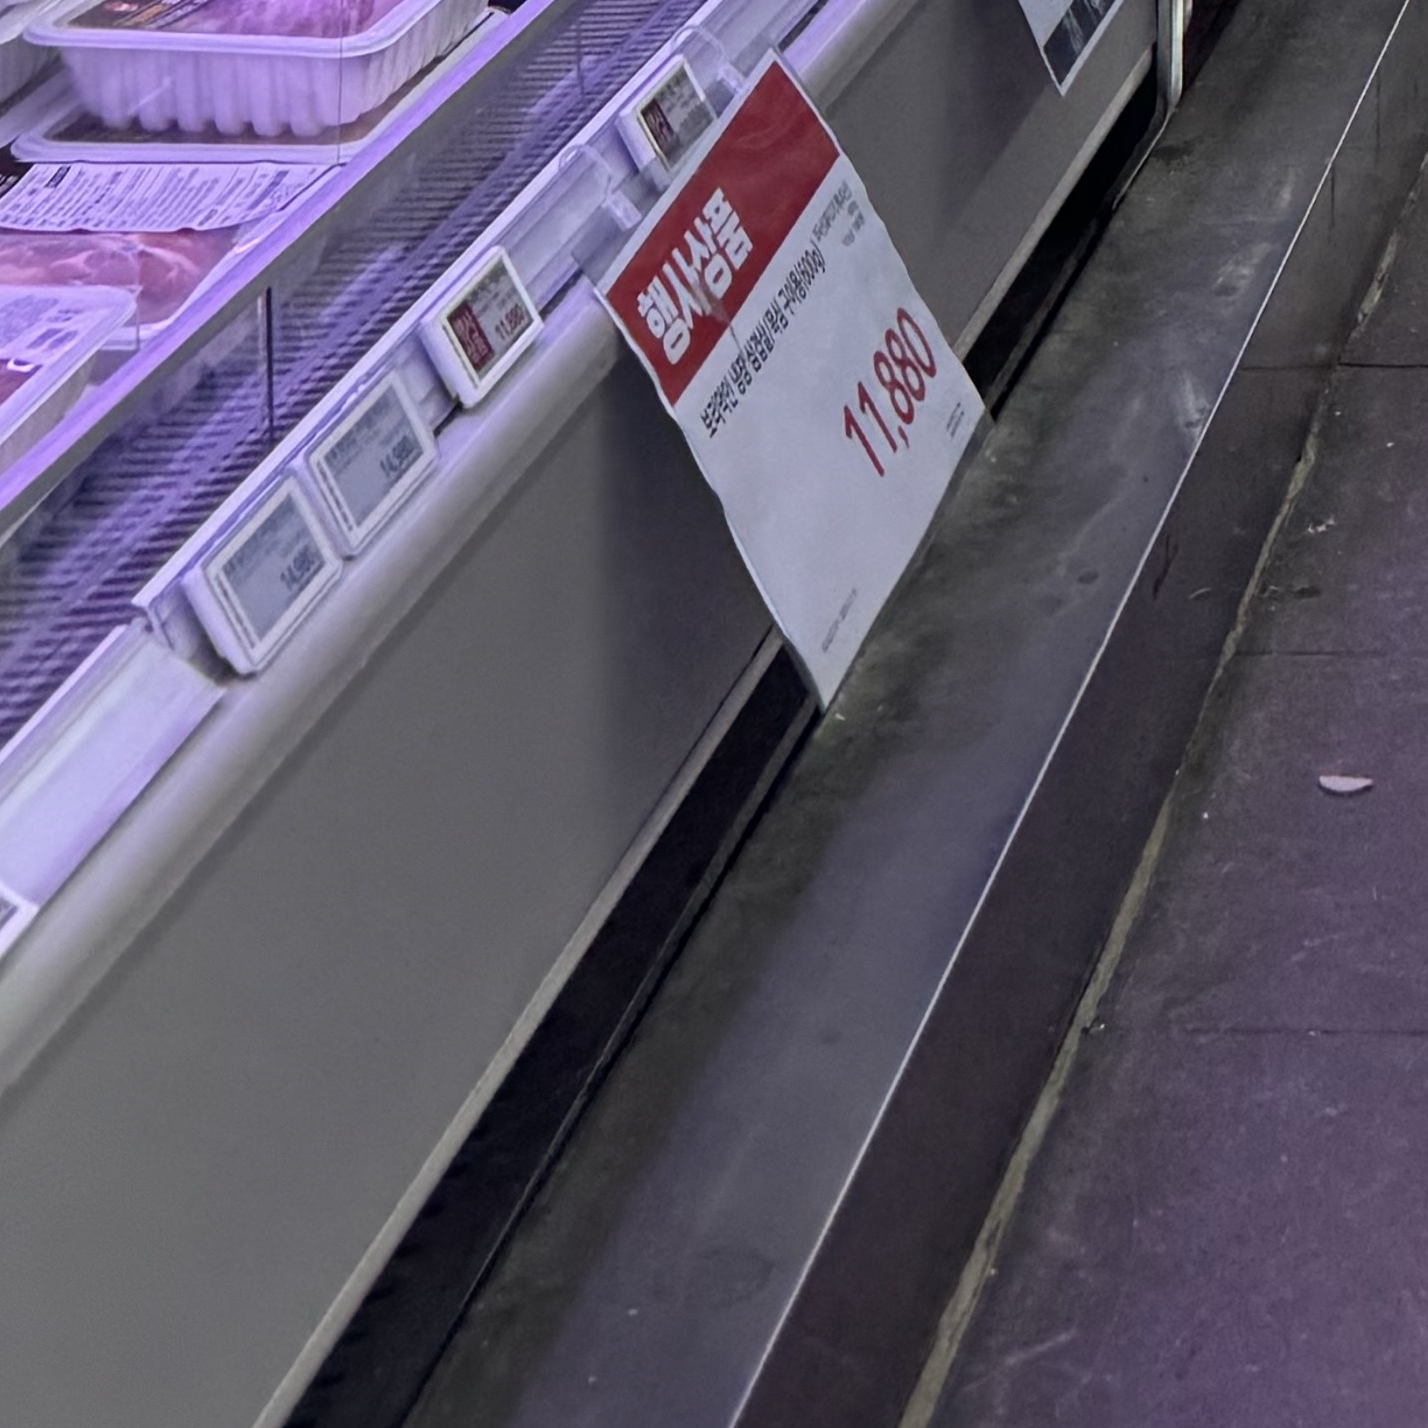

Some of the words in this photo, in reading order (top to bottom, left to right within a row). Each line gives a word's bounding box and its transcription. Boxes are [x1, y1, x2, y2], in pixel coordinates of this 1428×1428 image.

[637, 186, 754, 366] 행사상품
[725, 349, 756, 397] 냉장
[844, 306, 937, 478] 11,880
